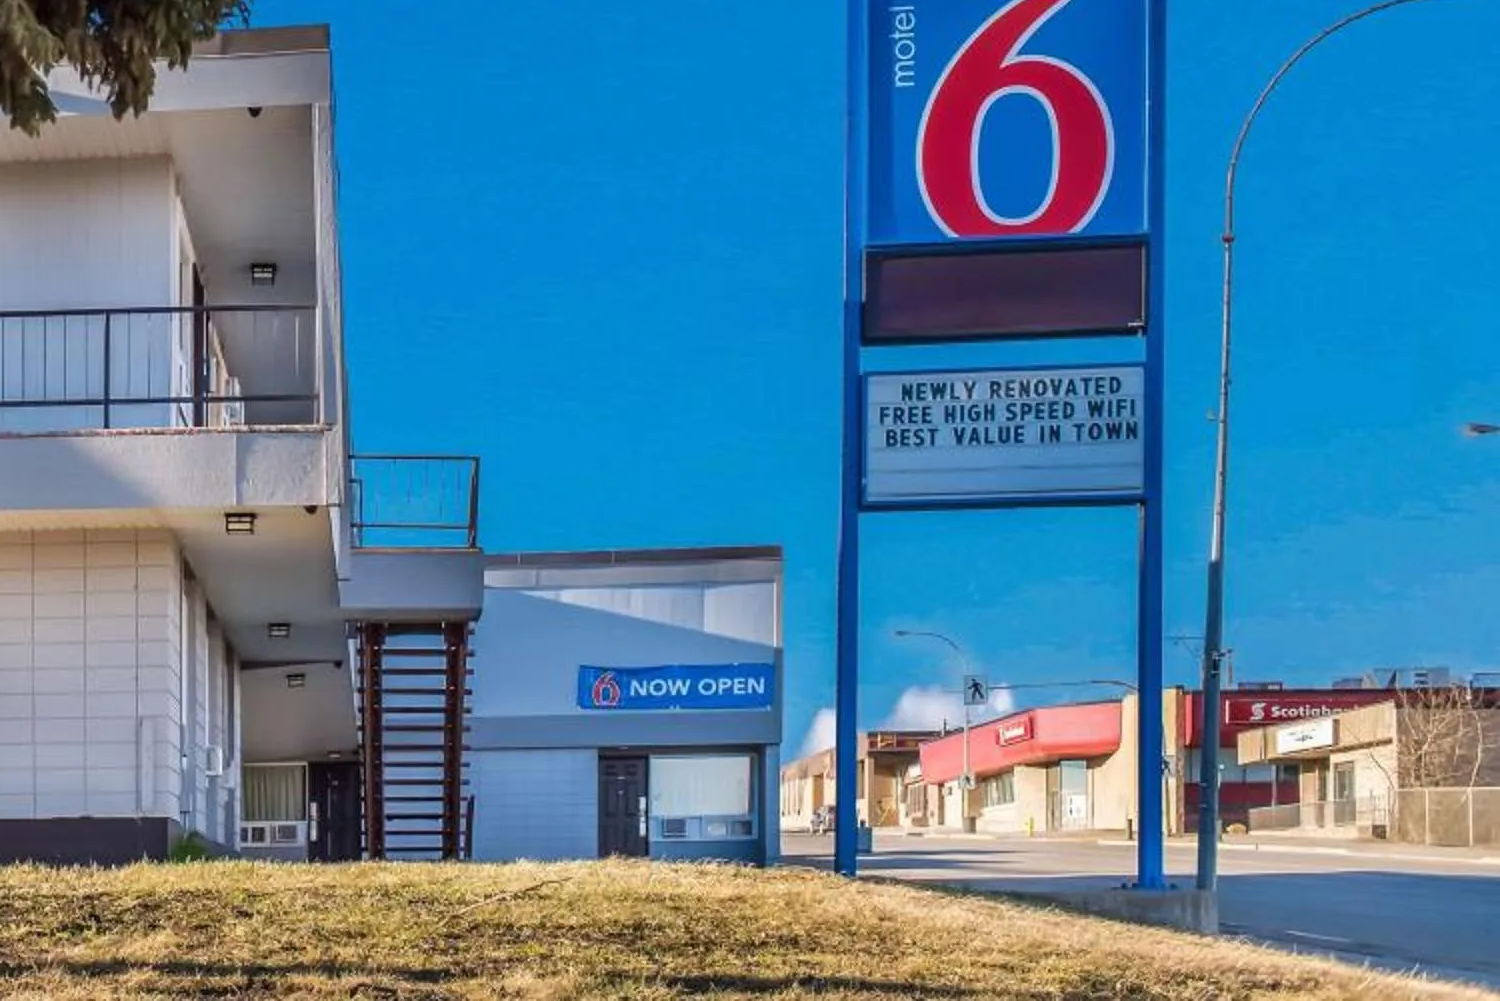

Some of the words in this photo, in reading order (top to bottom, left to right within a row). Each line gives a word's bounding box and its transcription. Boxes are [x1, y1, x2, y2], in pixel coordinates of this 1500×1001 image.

[888, 5, 916, 88] motel
[901, 381, 977, 401] NEWLY
[988, 376, 1122, 398] RENOVATED
[879, 406, 933, 425] FREE
[943, 404, 996, 423] HIGH
[1005, 401, 1075, 421] SPEED
[1087, 398, 1136, 418] WIFI
[885, 428, 940, 448] BEST
[952, 425, 1025, 445] VALUE
[1039, 424, 1061, 443] IN
[1074, 421, 1139, 441] TOWN
[591, 670, 621, 706] 6
[629, 678, 691, 697] NOW
[698, 676, 765, 696] OPEN
